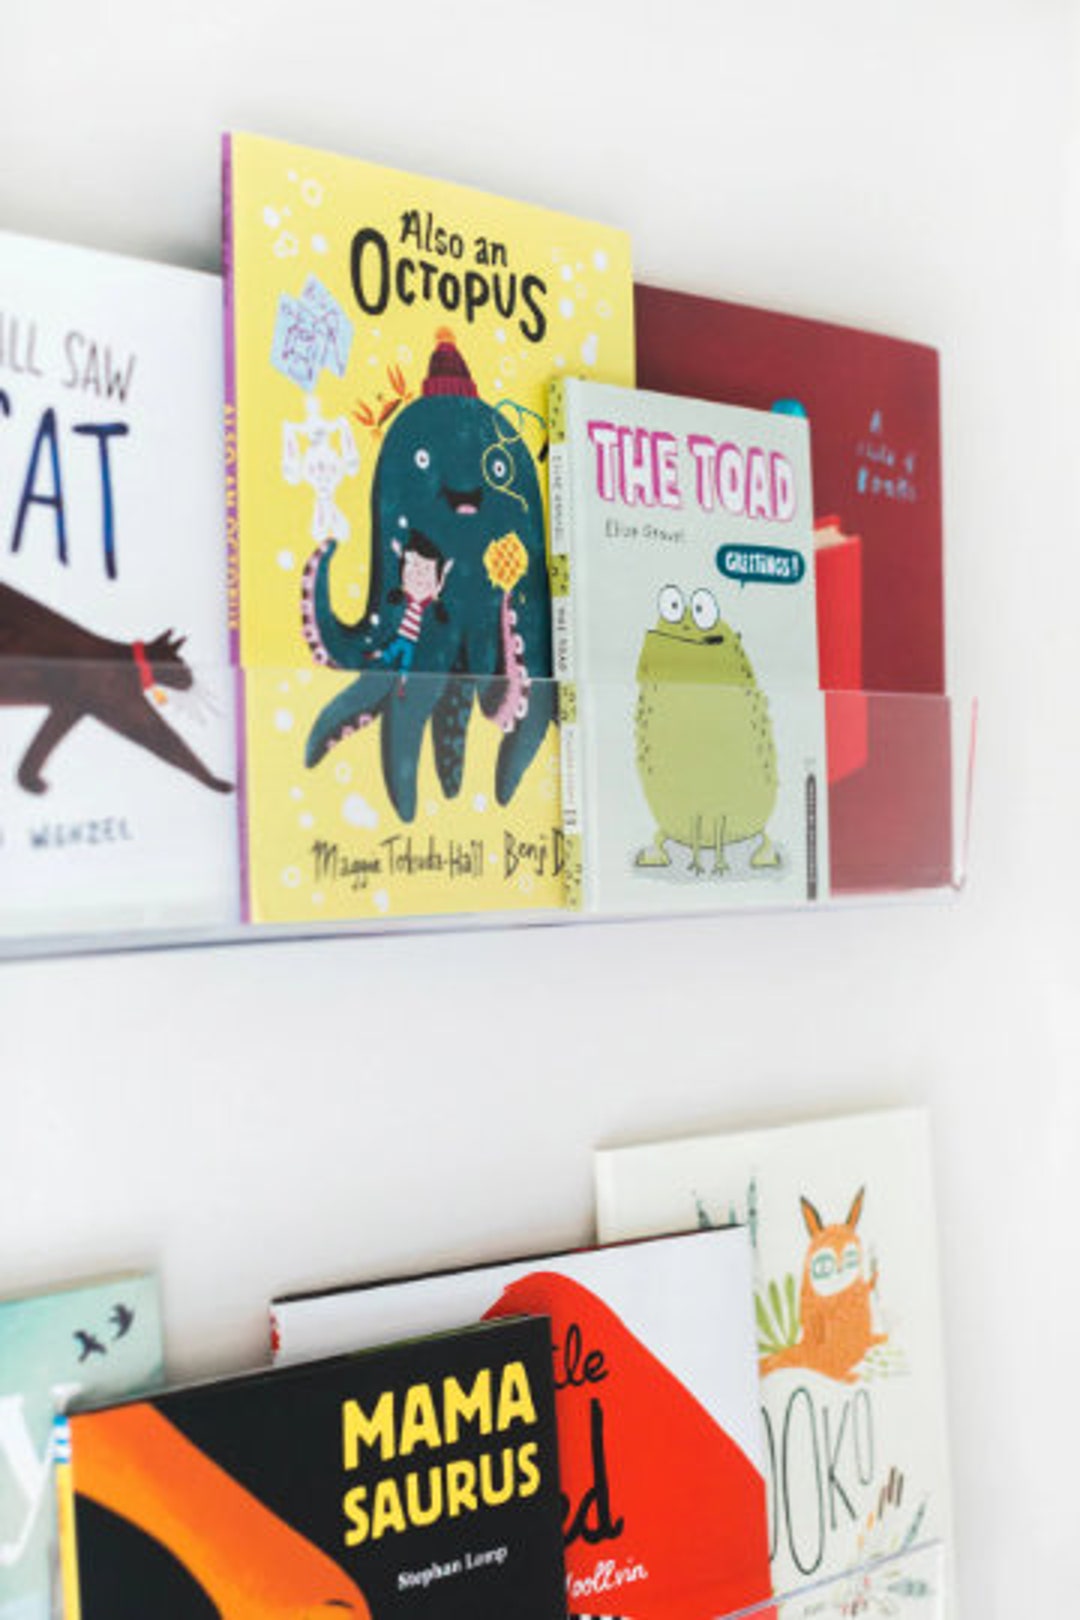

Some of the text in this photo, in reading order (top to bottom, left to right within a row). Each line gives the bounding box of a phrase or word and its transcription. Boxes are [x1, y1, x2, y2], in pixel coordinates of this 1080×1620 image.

[349, 227, 548, 344] OCTOPUS
[400, 209, 508, 268] Also an
[61, 329, 137, 403] SAW
[587, 420, 682, 509] THE
[687, 434, 796, 523] TOAD
[342, 1360, 538, 1472] MAMA
[343, 1442, 541, 1547] SAURUS
[397, 1559, 463, 1591] Stephan
